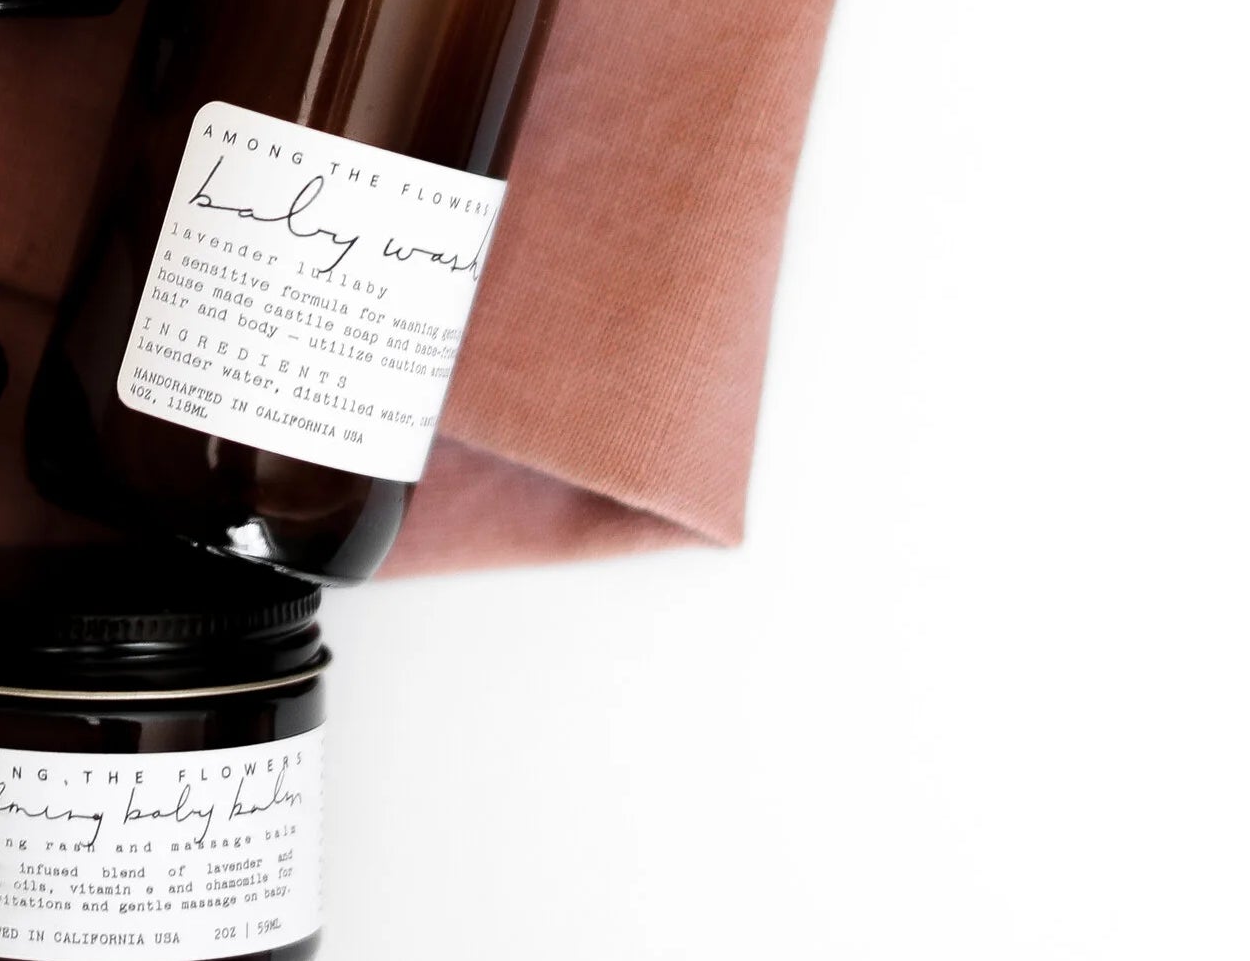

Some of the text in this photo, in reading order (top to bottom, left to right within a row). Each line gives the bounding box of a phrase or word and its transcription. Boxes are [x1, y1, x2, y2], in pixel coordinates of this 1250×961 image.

[202, 124, 488, 216] AMONG THE FLOWERS
[188, 155, 497, 281] baby wash
[162, 248, 172, 262] a
[181, 255, 269, 291] sensitive
[280, 285, 347, 315] formula
[359, 307, 385, 323] for
[392, 317, 439, 340] washing
[170, 221, 388, 299] lavender lullaby
[151, 285, 189, 308] hair
[197, 303, 227, 321] and
[237, 313, 278, 338] body
[308, 336, 373, 362] utilize
[380, 356, 426, 375] caution
[157, 265, 410, 352] house made castile soap and
[136, 335, 212, 370] lavender
[222, 365, 279, 394] water,
[292, 385, 374, 417] distilled
[380, 408, 414, 426] water,
[141, 316, 346, 388] INGREDIENTS
[133, 366, 363, 445] HANDCRAFTED IN CALIFORNIA USA
[167, 396, 207, 419] 118ML
[82, 769, 144, 785] THE
[177, 750, 301, 782] FLOWERS
[44, 838, 96, 853] rash
[114, 840, 152, 854] and
[170, 834, 251, 851] massage
[123, 784, 215, 844] baby
[228, 768, 301, 821] balm
[12, 878, 54, 895] oils,
[69, 882, 131, 896] vitamin
[144, 884, 154, 895] e
[167, 880, 193, 894] and
[205, 873, 269, 892] chamomile
[18, 847, 293, 879] infused blend of lavender and
[27, 928, 45, 942] IN
[52, 930, 145, 946] CALIFORNIA
[153, 931, 181, 945] USA
[257, 917, 281, 935] 59ML
[80, 899, 109, 913] and
[117, 898, 172, 915] gentle
[180, 894, 237, 910] massage
[243, 891, 258, 903] on
